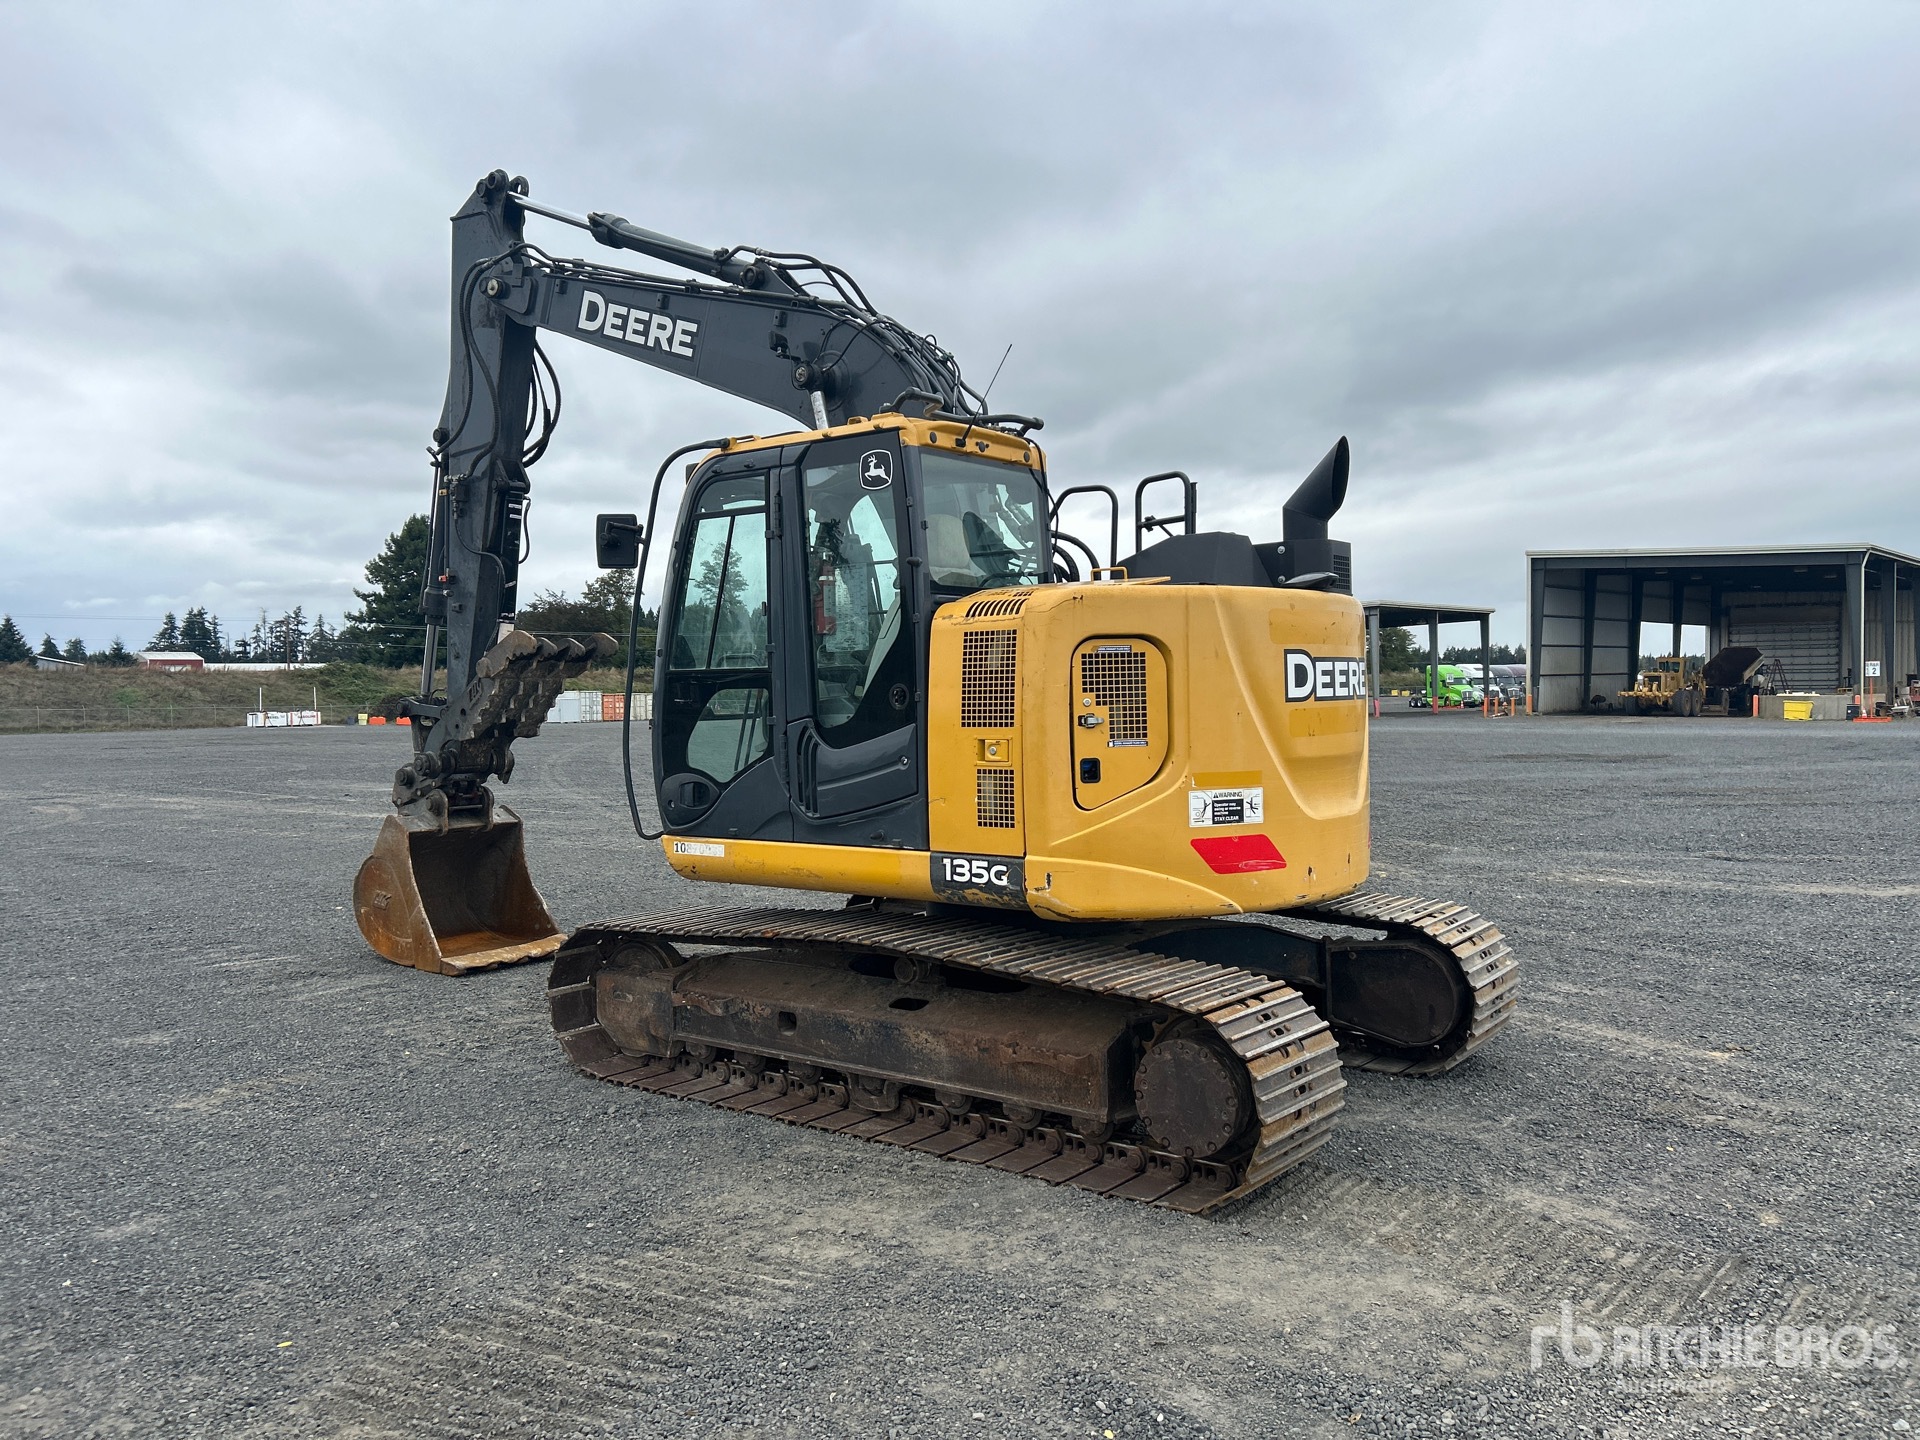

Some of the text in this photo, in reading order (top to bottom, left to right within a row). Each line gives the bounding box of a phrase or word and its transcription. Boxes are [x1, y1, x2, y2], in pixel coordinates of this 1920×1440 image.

[577, 290, 698, 358] DEERE
[1286, 653, 1366, 698] DEERE
[942, 858, 1008, 886] 135G
